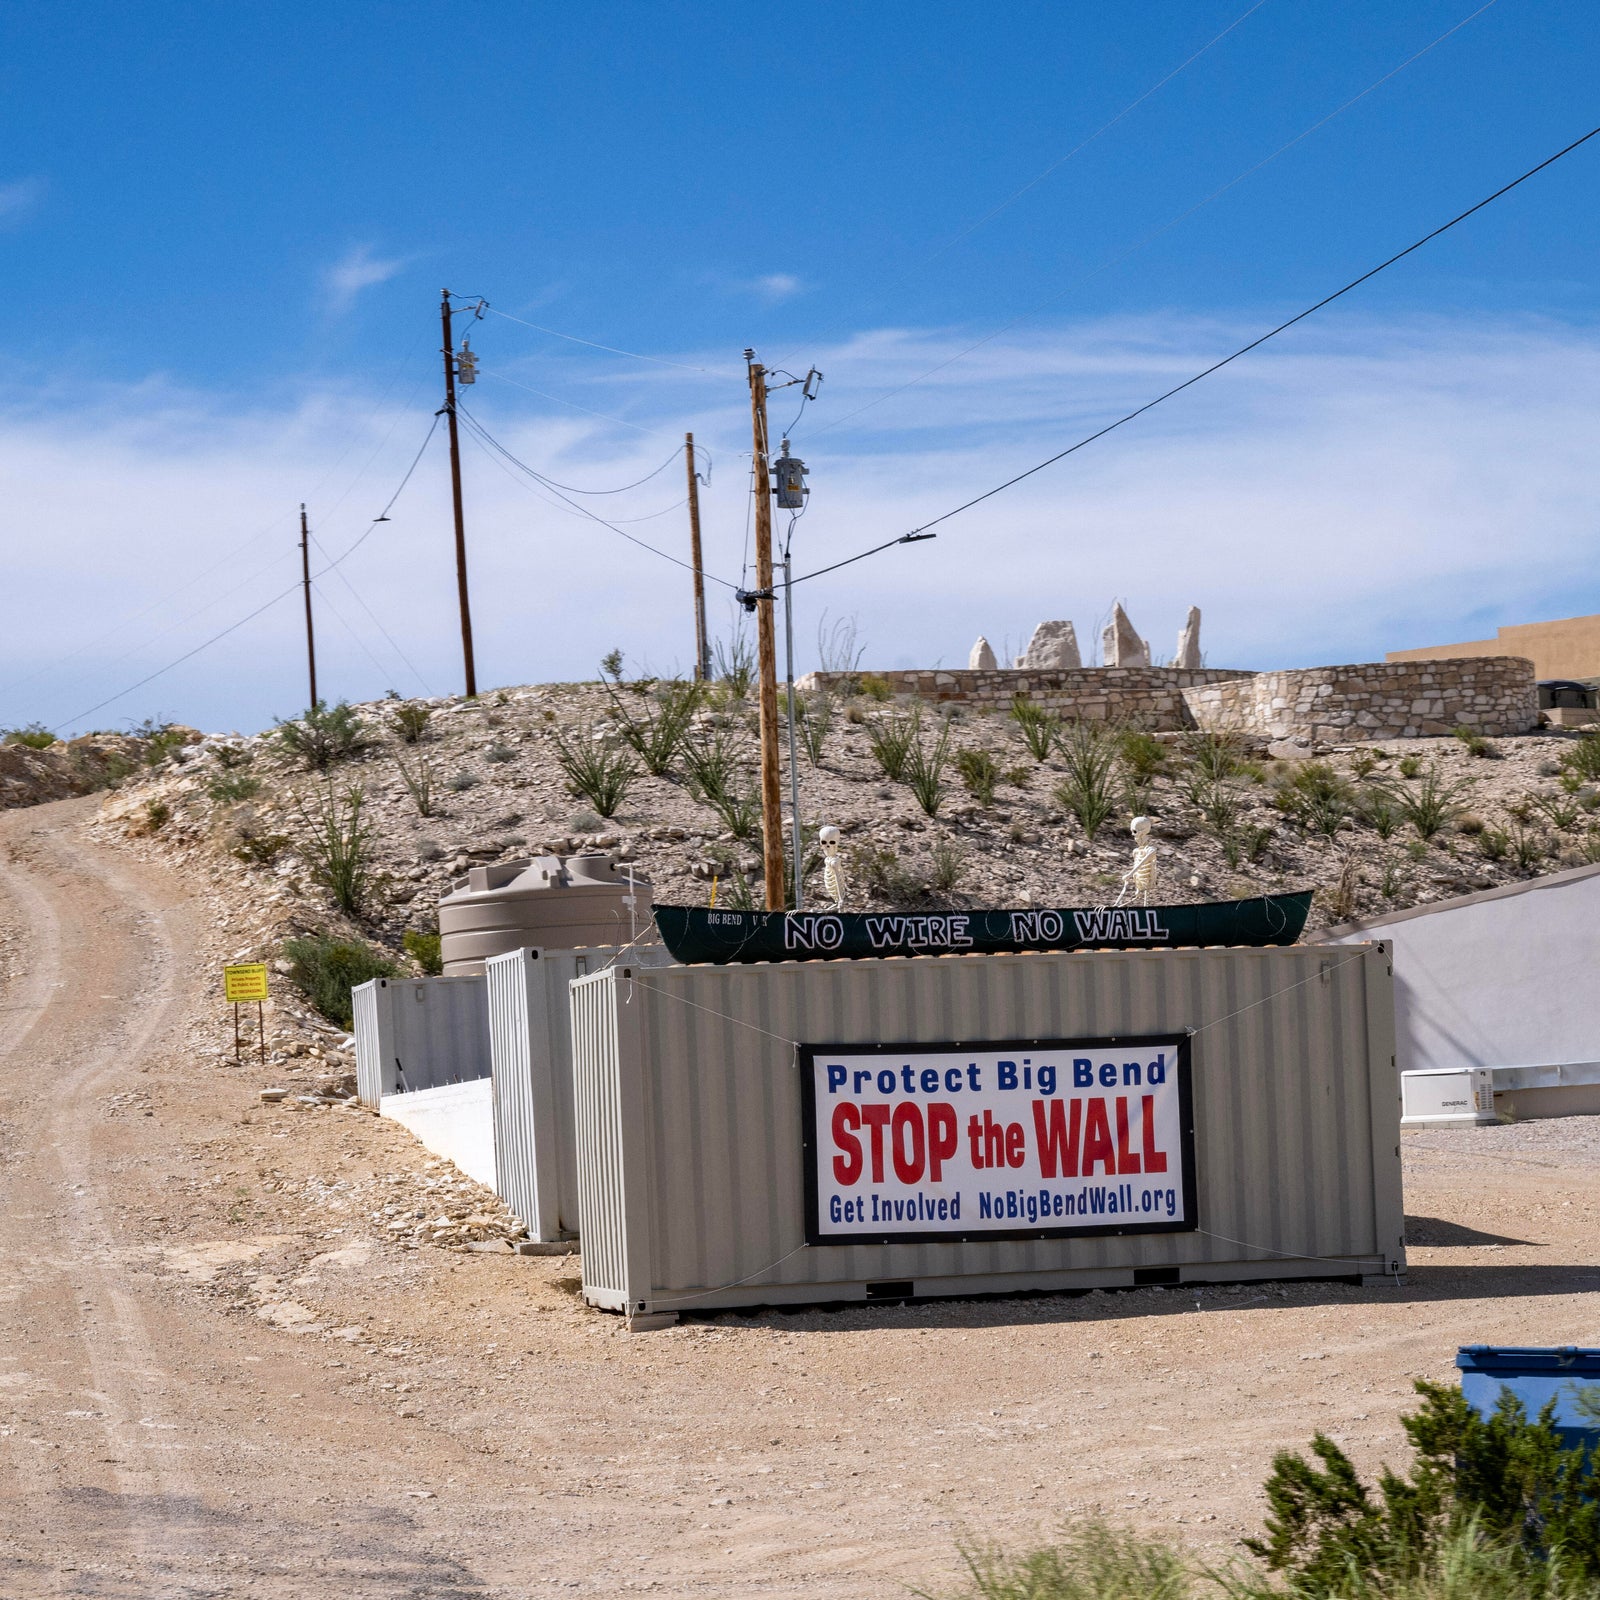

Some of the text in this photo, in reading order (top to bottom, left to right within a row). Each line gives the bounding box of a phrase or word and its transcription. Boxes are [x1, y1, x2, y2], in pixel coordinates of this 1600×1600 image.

[707, 913, 720, 925] BIG
[722, 913, 742, 926] BEND
[784, 909, 1169, 950] NO WIRE NO WALL
[827, 1054, 1166, 1095] Protect Big Bend
[831, 1095, 1168, 1186] STOP the WALL
[830, 1184, 1176, 1223] Get Involved NoBigBendWall.org
